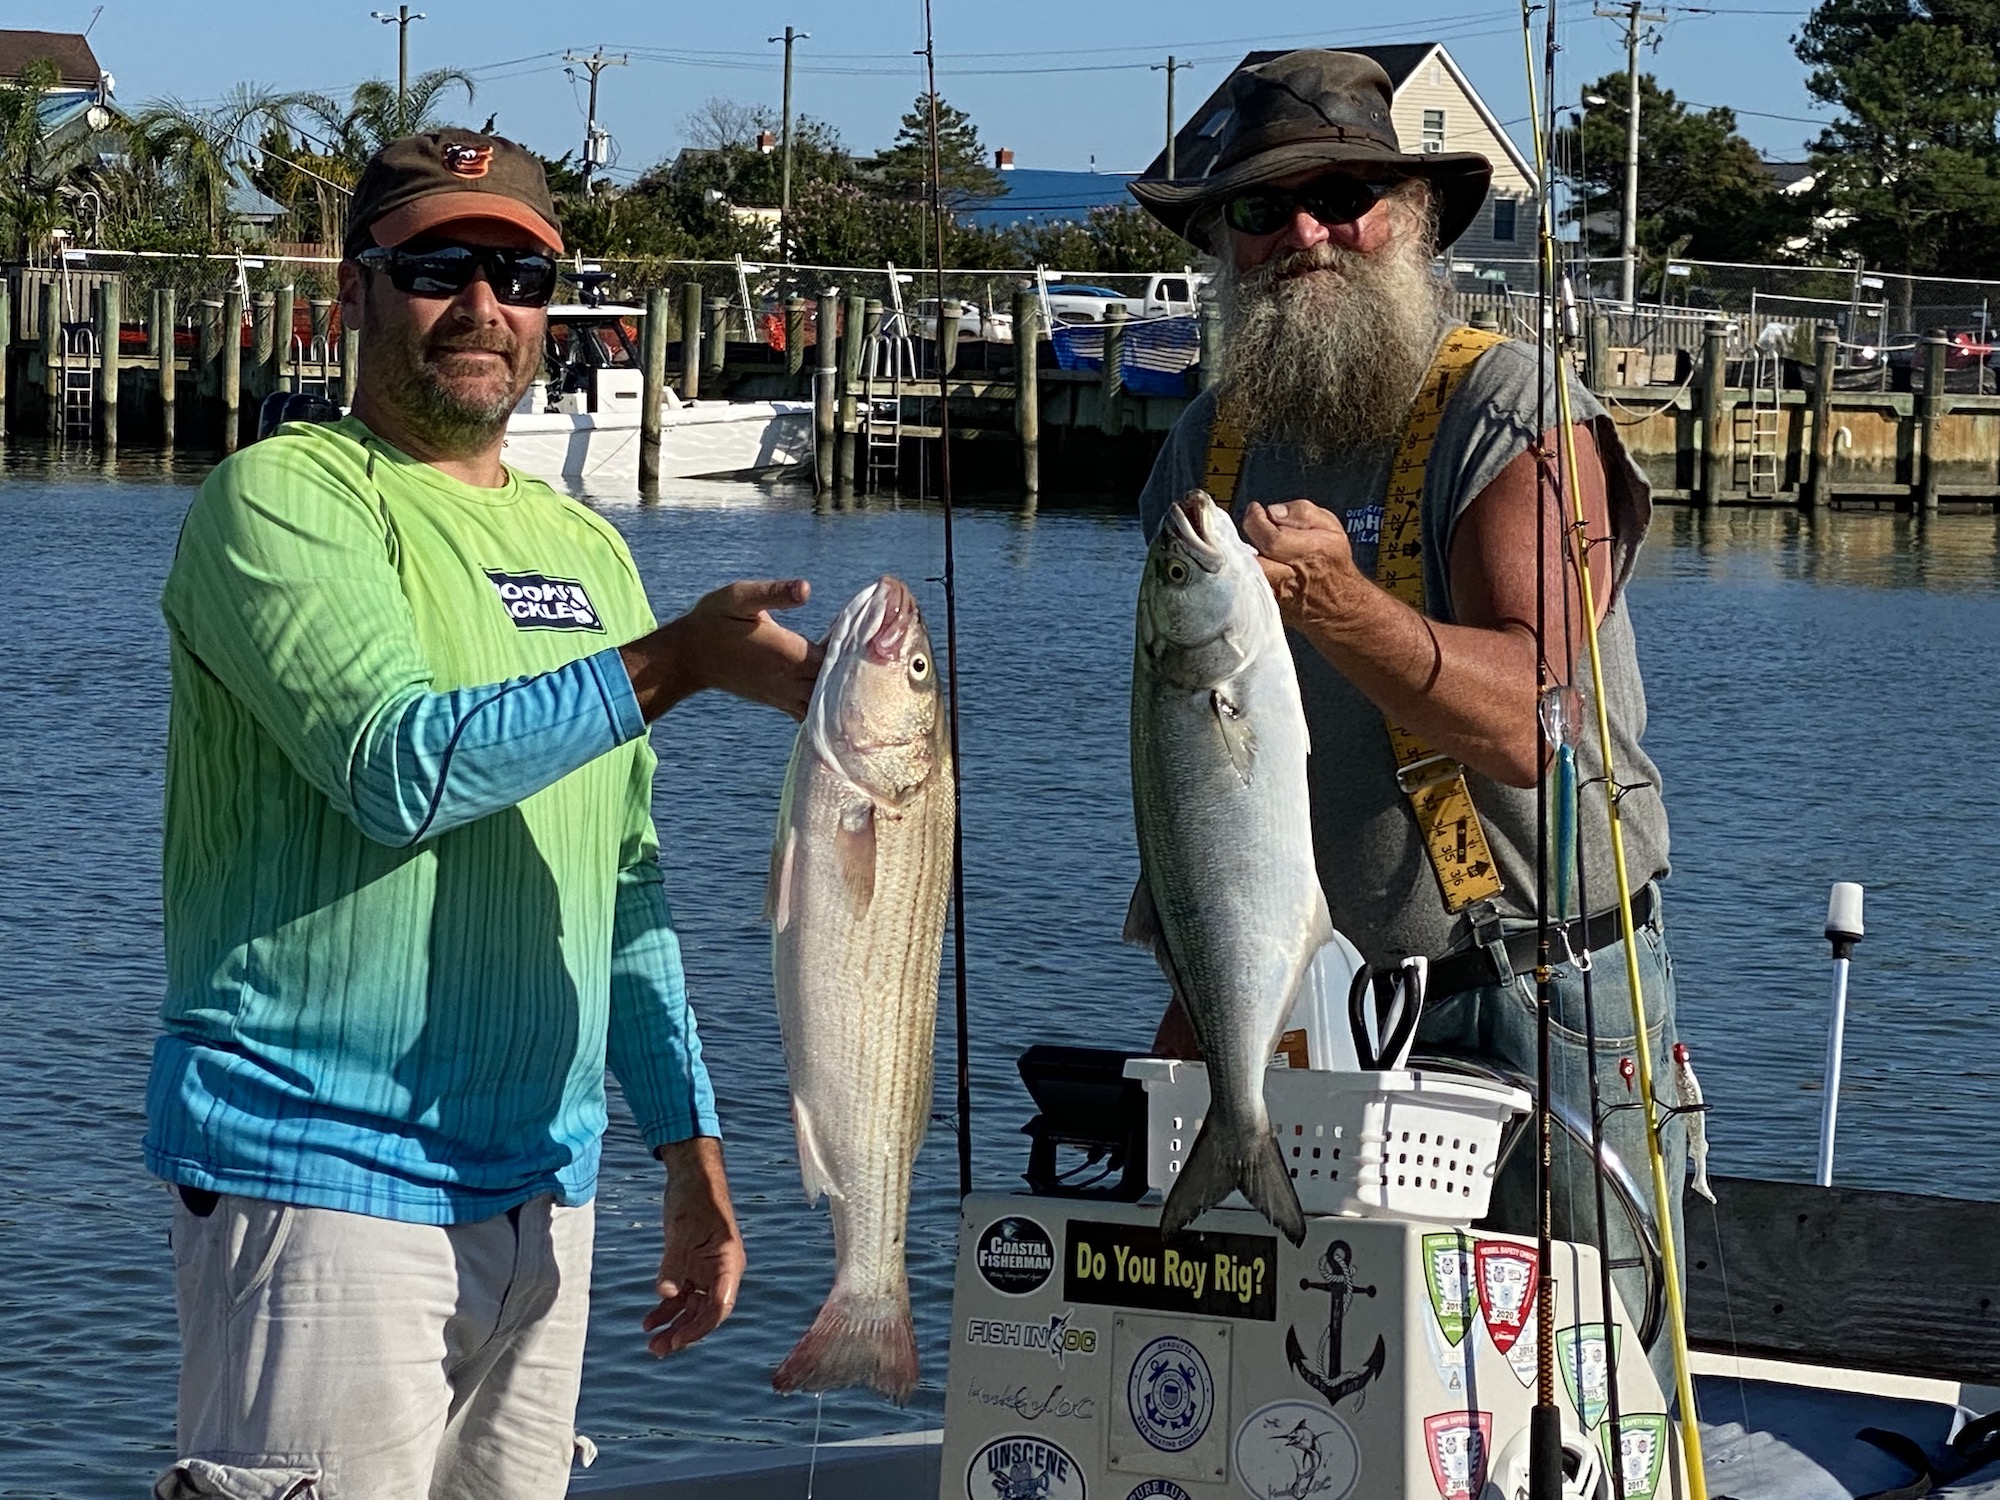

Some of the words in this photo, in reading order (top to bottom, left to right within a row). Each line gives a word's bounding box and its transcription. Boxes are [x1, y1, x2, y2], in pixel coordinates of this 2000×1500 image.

[1395, 486, 1405, 504] 22
[1386, 571, 1396, 588] 25
[1423, 794, 1437, 812] 33
[1432, 819, 1447, 837] 34
[1441, 844, 1456, 862] 35
[1450, 869, 1464, 886] 36
[990, 1236, 1048, 1256] COASTAL
[1500, 1246, 1520, 1256] SAFETY
[1520, 1250, 1537, 1262] CHECK
[980, 1250, 1052, 1270] FISHERMAN
[1076, 1241, 1106, 1280] Do
[1113, 1244, 1156, 1285] You
[1164, 1249, 1208, 1300] Roy
[1214, 1252, 1266, 1304] Rig?
[1496, 1310, 1514, 1320] 2020
[968, 1320, 1020, 1346] FISH
[1024, 1325, 1049, 1348] IN
[1064, 1329, 1096, 1353] OC
[987, 1442, 1070, 1484] UNSCENE
[1163, 1482, 1187, 1500] LUB
[1628, 1480, 1644, 1490] 2017
